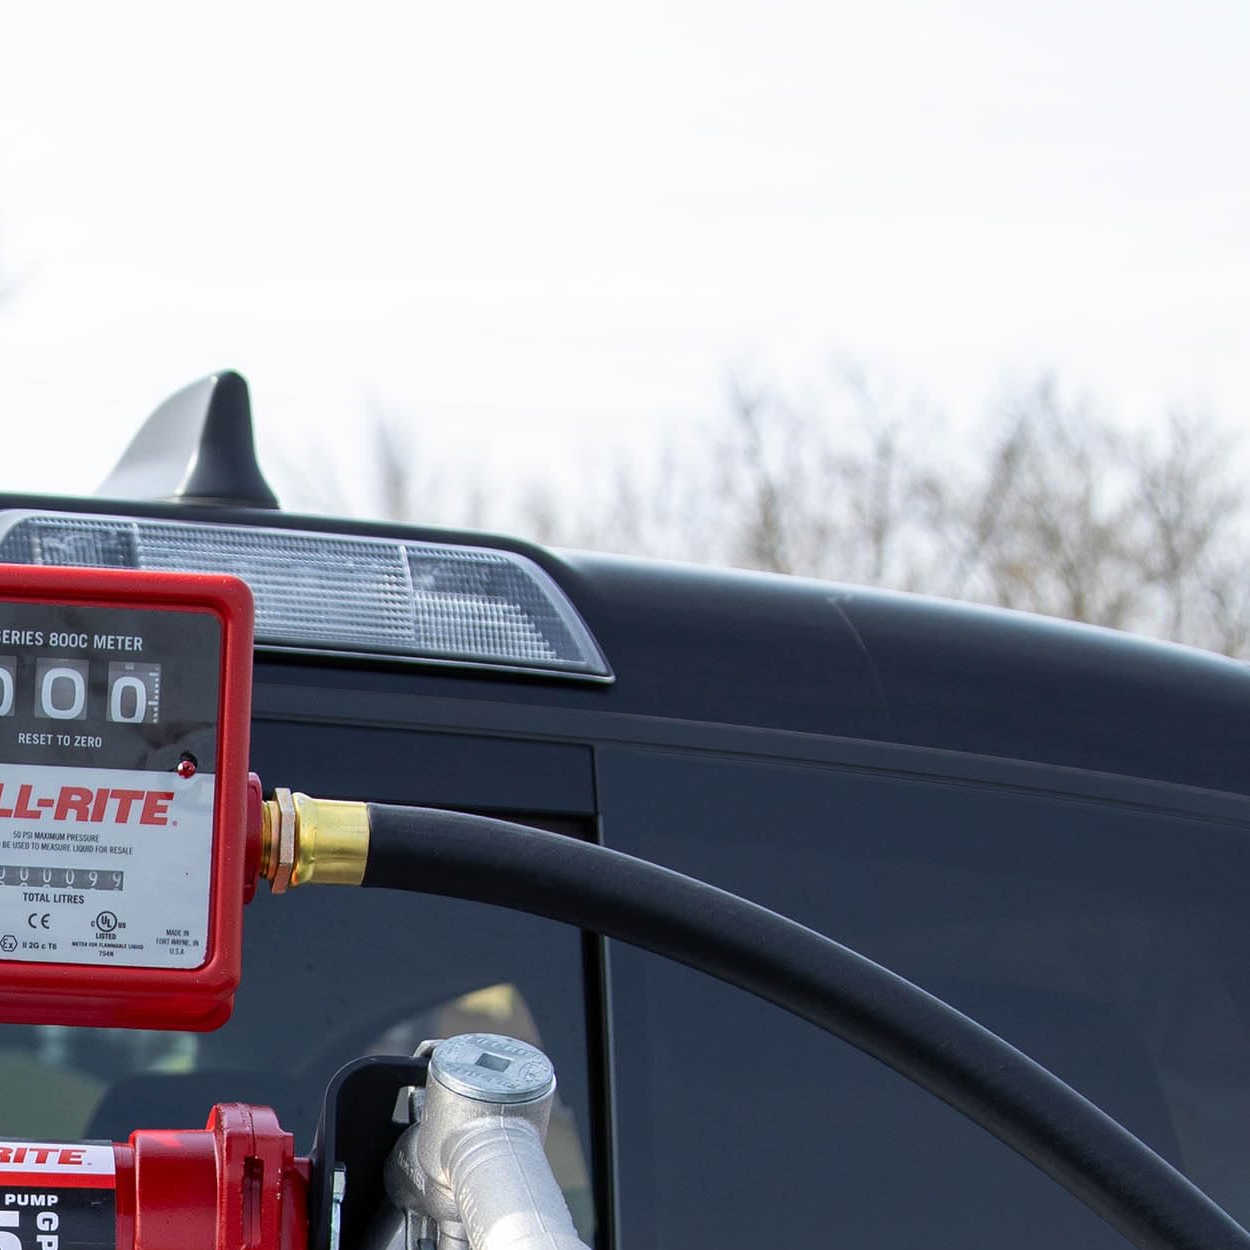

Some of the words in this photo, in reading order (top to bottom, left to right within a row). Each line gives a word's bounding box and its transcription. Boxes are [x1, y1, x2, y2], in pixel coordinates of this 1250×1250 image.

[49, 632, 88, 648] 800C
[93, 634, 143, 651] METER
[18, 732, 53, 746] RESET
[57, 734, 70, 746] TO
[74, 735, 102, 748] ZERO
[13, 830, 21, 839] 50
[22, 831, 33, 840] PSI
[34, 831, 65, 841] MAXIMUM
[66, 833, 100, 843] PRESSURE
[2, 840, 11, 849] BE
[12, 841, 30, 850] USED
[31, 842, 39, 850] TO
[40, 842, 71, 852] MEASURE
[72, 844, 94, 854] LIQUID
[95, 845, 108, 854] FOR
[109, 846, 134, 855] RESALE
[23, 892, 50, 903] TOTAL
[53, 894, 85, 904] LITRES
[47, 942, 57, 950] T6
[5, 1193, 59, 1206] PUMP
